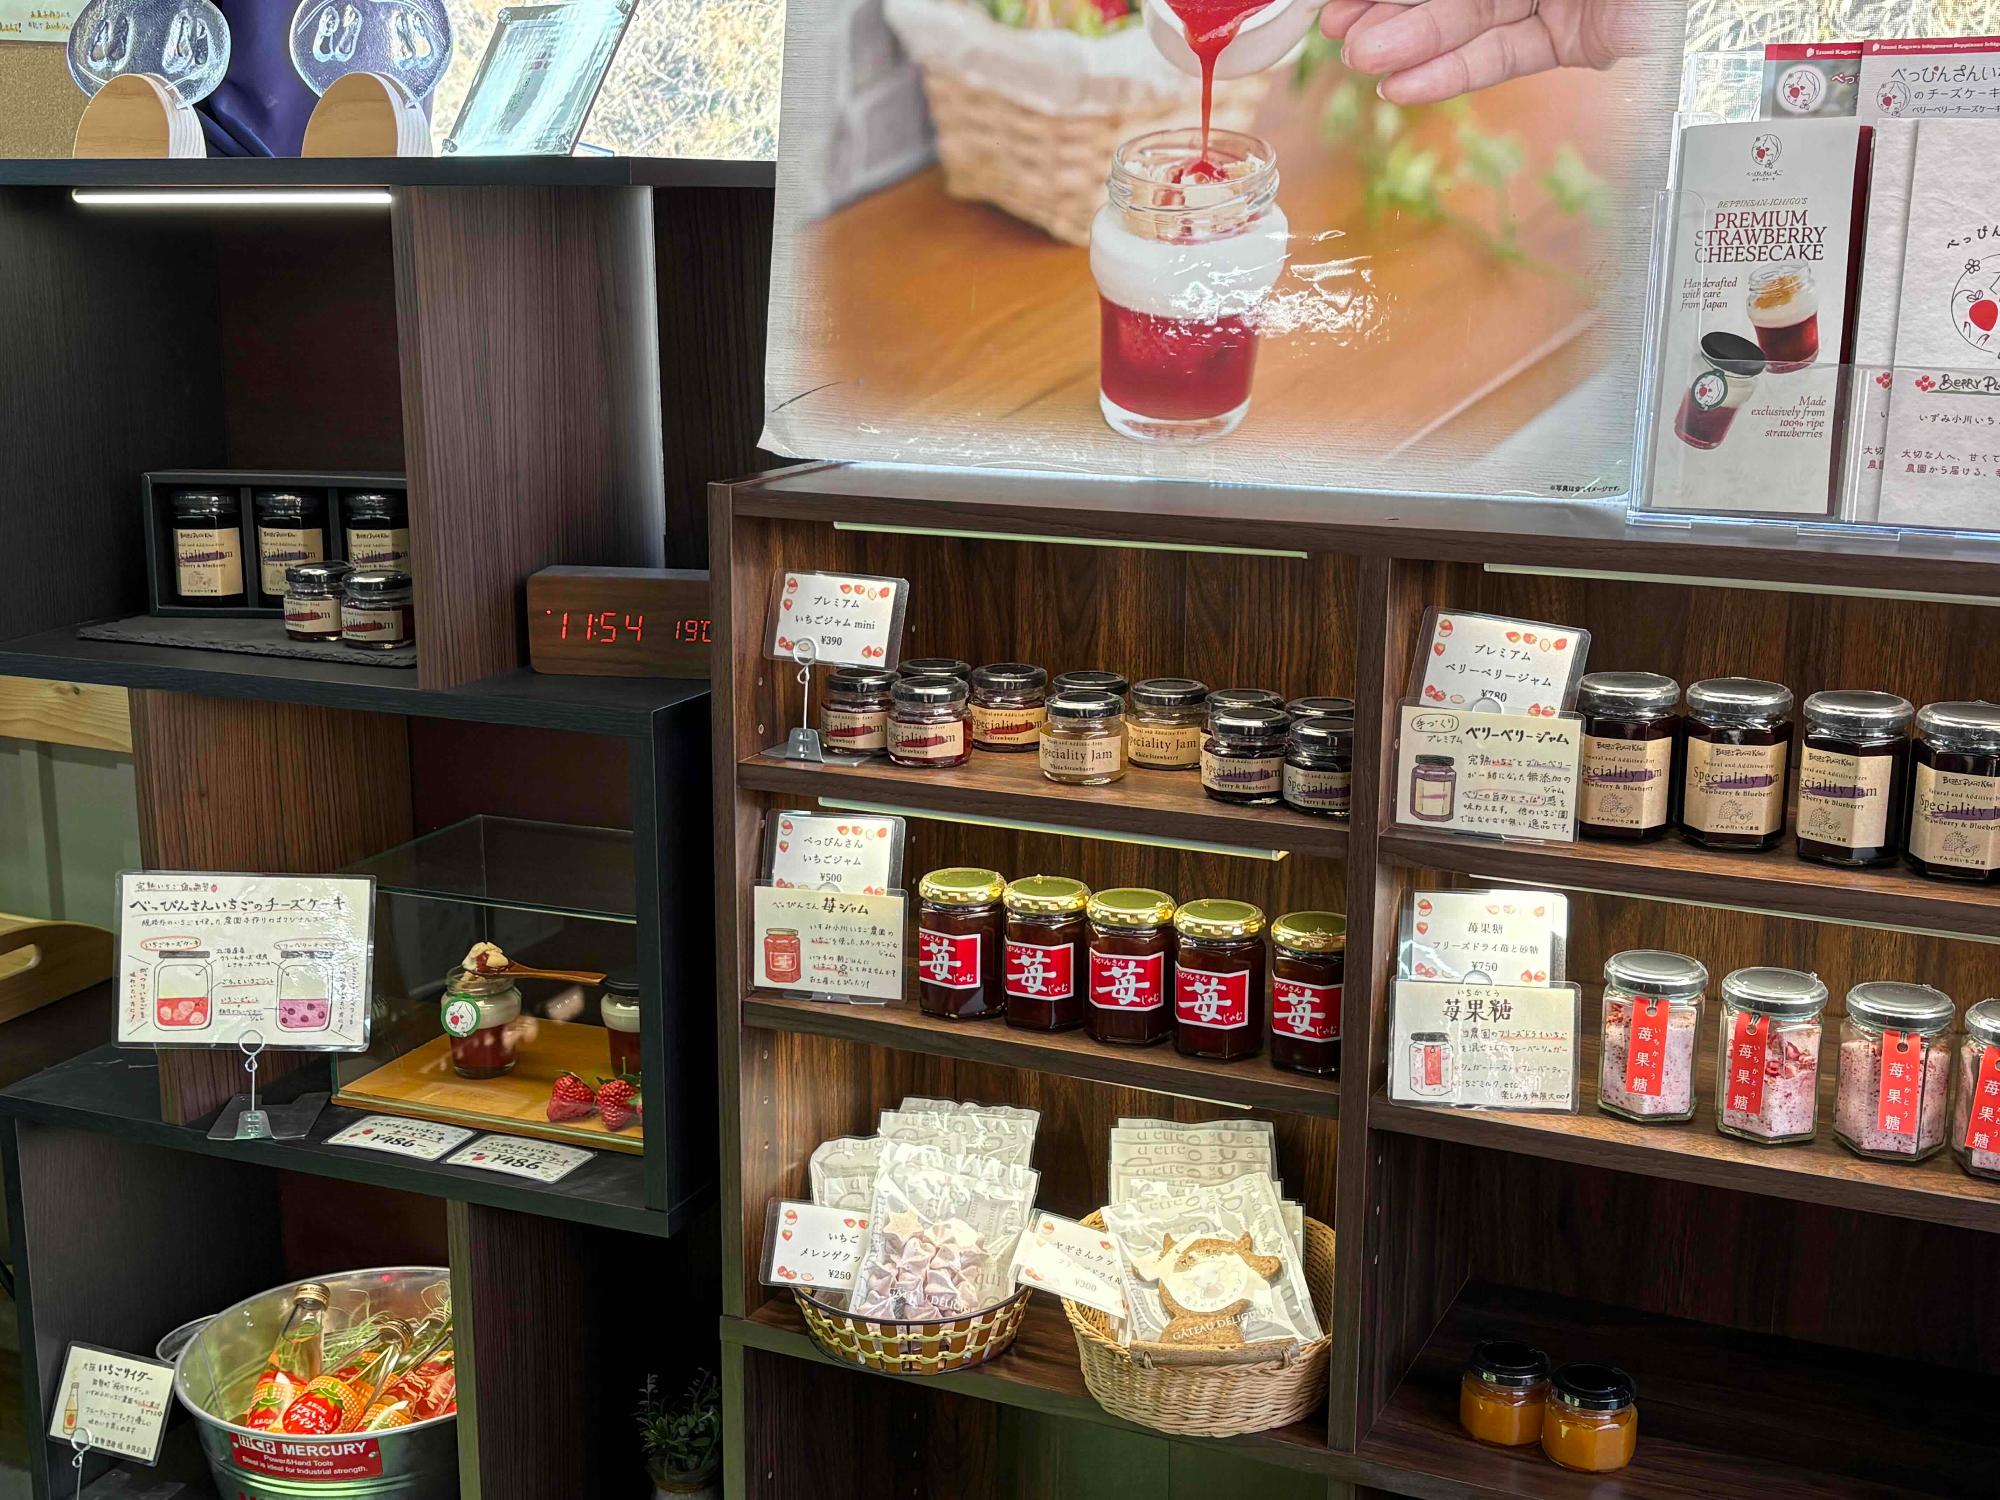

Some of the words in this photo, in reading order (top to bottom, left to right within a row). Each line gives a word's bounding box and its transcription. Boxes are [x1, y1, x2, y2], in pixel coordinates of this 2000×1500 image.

[1714, 210, 1808, 229] PREMIUM
[1694, 226, 1828, 247] STRAWBERRY
[1695, 244, 1824, 264] CHEESECAKE
[1684, 276, 1738, 289] Handcrafted
[1682, 288, 1700, 298] with
[1680, 299, 1700, 312] from
[1702, 299, 1728, 312] Japan
[1800, 396, 1826, 406] Made
[1751, 406, 1800, 420] exclusively
[1800, 408, 1825, 418] from
[1764, 429, 1823, 438] strawberries
[1780, 420, 1804, 428] 100%
[1806, 420, 1824, 430] ripe
[814, 595, 860, 608] プレミアム
[561, 611, 645, 642] 11:54
[796, 614, 851, 628] いちごジャム
[854, 620, 876, 630] mini
[821, 636, 842, 646] ¥390
[1474, 644, 1531, 662] プレミアム
[1446, 664, 1552, 687] ベリーベリージャム
[1426, 734, 1463, 744] プレミアム
[1466, 727, 1570, 745] ベリーベリージャム
[1175, 740, 1196, 750] Jam
[1091, 750, 1113, 762] Jam
[1205, 762, 1254, 779] Speciality
[1260, 768, 1281, 778] Jam
[1693, 766, 1757, 787] Speciality
[1852, 784, 1877, 797] Jam
[1832, 800, 1864, 811] Blueberry
[1920, 794, 1984, 818] Speciality
[804, 854, 862, 866] いちごジャム
[820, 872, 842, 883] ¥500
[822, 896, 868, 916] 苺ジャム
[1468, 922, 1503, 935] 苺果糖
[919, 938, 962, 980] 苺
[1472, 962, 1498, 972] ¥750
[1007, 950, 1057, 993] 苺
[1096, 961, 1150, 1005] 苺
[1178, 977, 1232, 1022] 苺
[1274, 989, 1326, 1034] 苺
[1442, 998, 1514, 1024] 苺果糖
[1632, 1026, 1653, 1092] 苺果糖
[1651, 1028, 1661, 1080] いちかとう
[1734, 1042, 1754, 1110] 苺果糖
[1750, 1045, 1760, 1098] いちかとう
[1884, 1062, 1904, 1131] 苺果糖
[1903, 1063, 1912, 1118] いちかとう
[828, 1232, 859, 1244] いちご
[828, 1269, 851, 1280] ¥250
[98, 1364, 153, 1382] いちごサイダー
[282, 1442, 367, 1457] MERCURY
[334, 1465, 368, 1474] strength.
